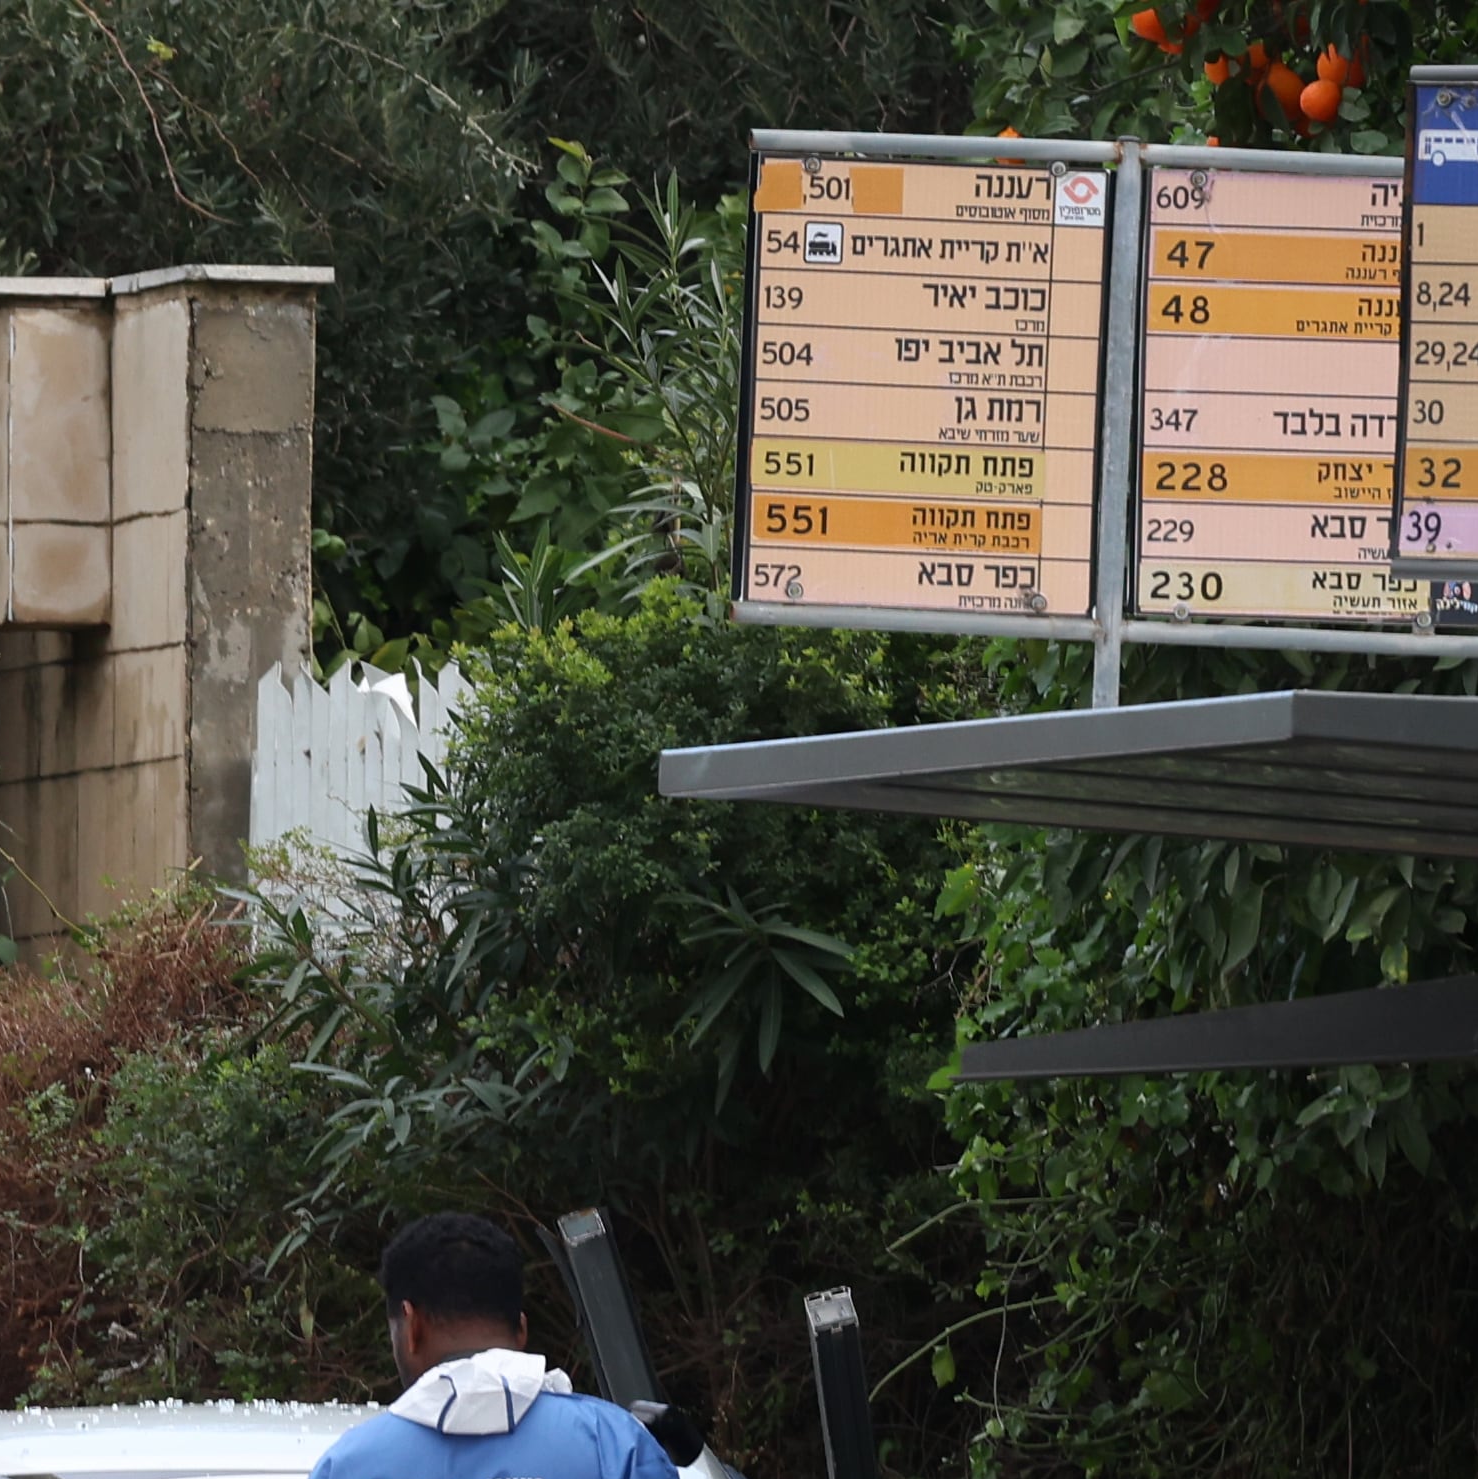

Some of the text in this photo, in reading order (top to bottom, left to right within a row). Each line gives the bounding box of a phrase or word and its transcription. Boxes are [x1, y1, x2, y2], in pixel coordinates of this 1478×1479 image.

[975, 174, 1051, 201] רעננה
[1157, 186, 1205, 209] 609
[1372, 183, 1403, 207] יה
[956, 205, 1017, 220] אוטובוסים
[1021, 208, 1050, 222] מסוף
[1059, 205, 1101, 218] מטרופולין
[766, 229, 800, 254] 54
[851, 235, 932, 258] אתגרים
[940, 239, 999, 264] קריית
[1167, 240, 1215, 270] 47
[1362, 244, 1401, 264] ננה
[1346, 267, 1387, 280] רעננה
[764, 285, 803, 310] 139
[923, 283, 1046, 312] כוכב יאיר
[1417, 283, 1471, 311] 8,24
[1162, 295, 1210, 324] 48
[1015, 319, 1045, 333] מרכז
[1296, 320, 1348, 334] אתגרים
[1354, 322, 1392, 336] קריית
[762, 342, 814, 366] 504
[896, 338, 1043, 367] תל אביב יפו
[949, 371, 978, 384] מרכז
[1010, 374, 1043, 388] רכבת
[760, 397, 810, 422] 505
[955, 396, 1041, 424] רמת גן
[1150, 408, 1198, 432] 347
[1413, 400, 1444, 424] 30
[1273, 408, 1341, 436] בלבד
[939, 427, 1040, 444] שער מזרחי שיבא
[764, 451, 814, 477] 551
[900, 452, 1033, 478] פתח תקווה
[1318, 462, 1373, 484] יצחק
[1418, 458, 1462, 488] 32
[1156, 462, 1228, 491] 228
[1334, 487, 1381, 500] היישוב
[766, 503, 829, 536] 551
[913, 507, 1031, 530] פתח תקווה
[1146, 519, 1195, 542] 229
[1311, 514, 1366, 538] סבא
[1406, 511, 1442, 543] 39
[913, 531, 1030, 550] רכבת קרית אריה
[754, 564, 802, 588] 572
[918, 561, 1036, 589] כפר סבא
[1151, 571, 1223, 601] 230
[1312, 571, 1361, 590] סבא
[958, 594, 1001, 609] מרכזית
[1333, 595, 1418, 610] אזור תעשיה
